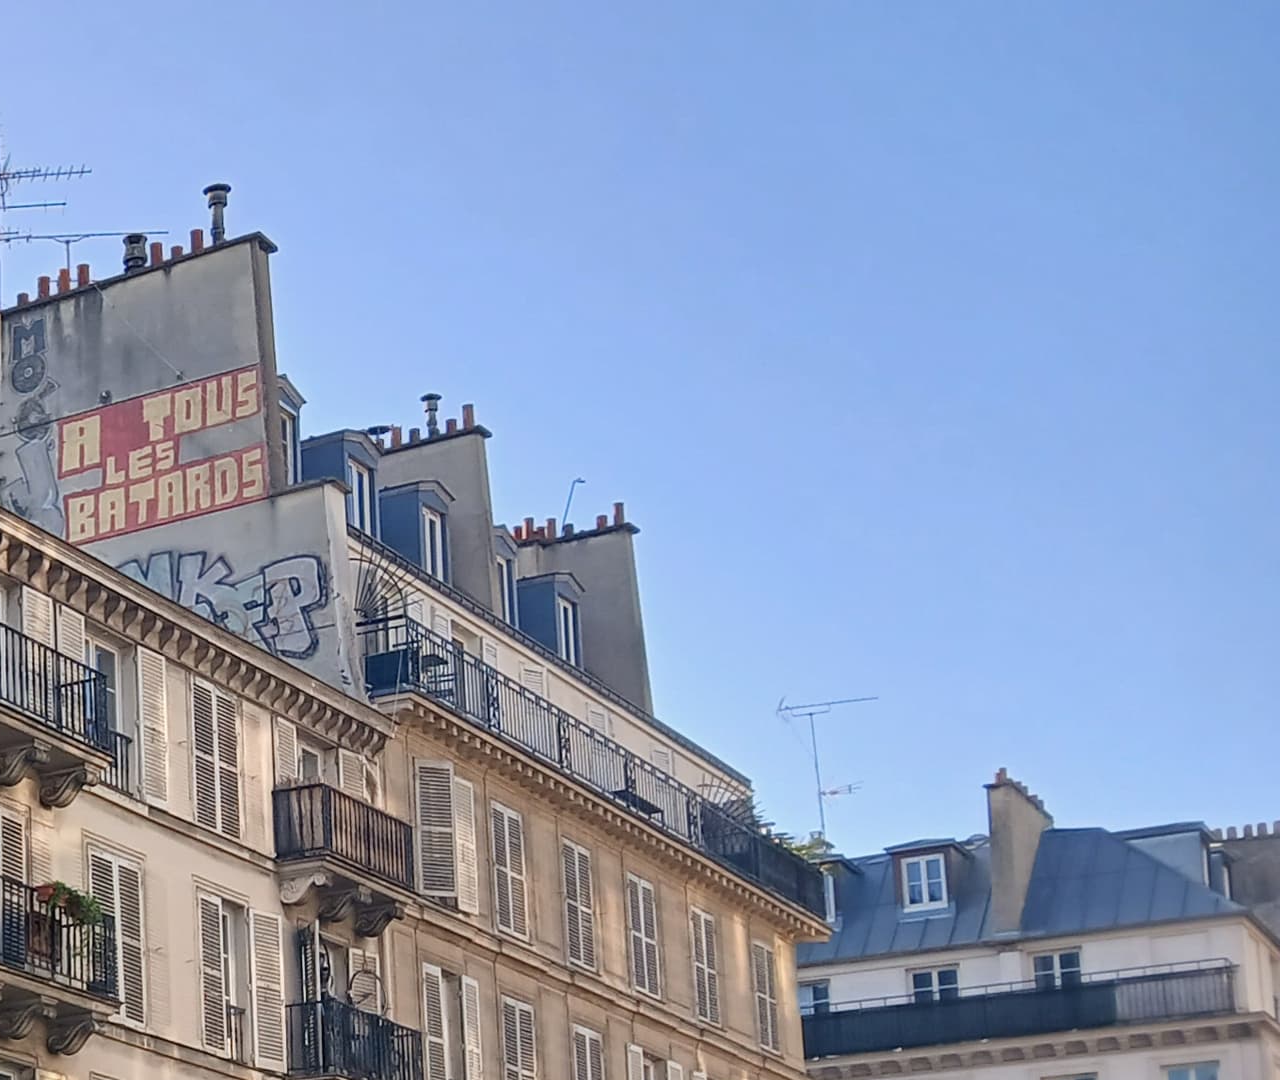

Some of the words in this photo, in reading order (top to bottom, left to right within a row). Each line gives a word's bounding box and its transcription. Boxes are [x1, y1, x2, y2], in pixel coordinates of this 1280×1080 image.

[62, 415, 100, 474] A
[143, 370, 258, 442] TOUS
[106, 440, 175, 485] LES
[68, 447, 264, 543] BATARDS
